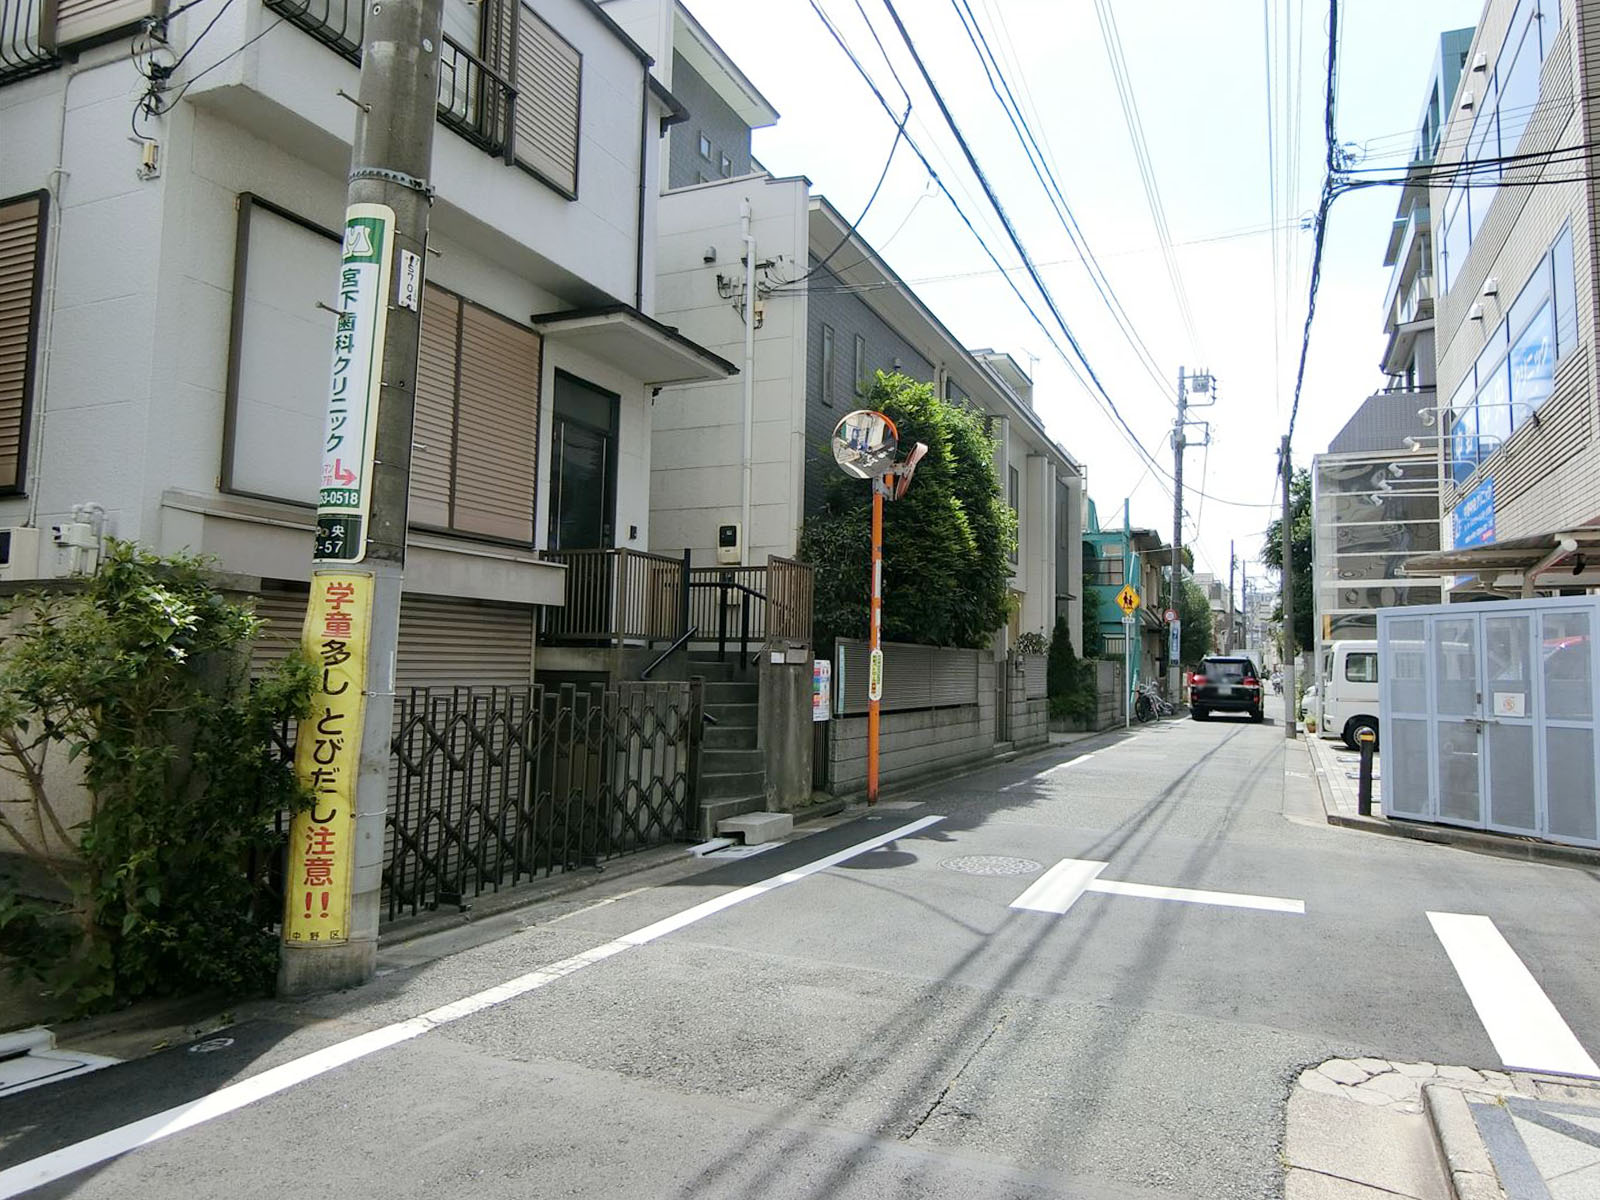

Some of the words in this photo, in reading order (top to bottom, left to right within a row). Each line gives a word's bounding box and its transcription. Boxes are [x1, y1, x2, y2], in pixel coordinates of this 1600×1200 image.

[326, 268, 361, 452] 宮下歯科クリニック
